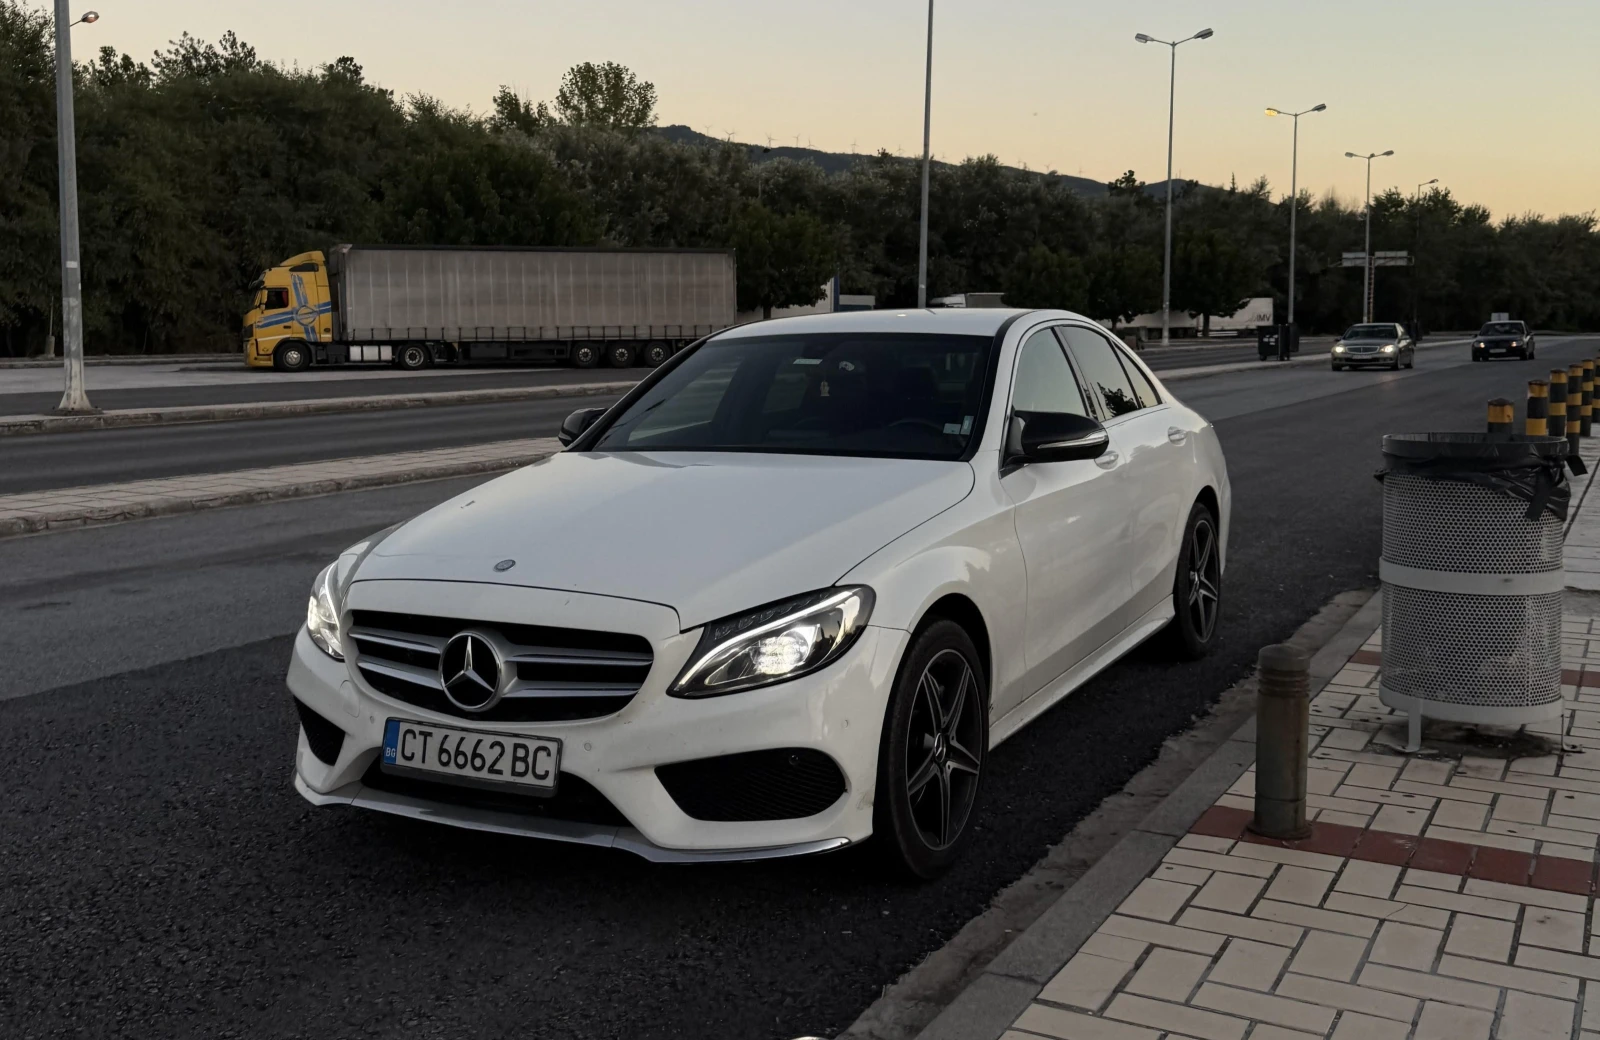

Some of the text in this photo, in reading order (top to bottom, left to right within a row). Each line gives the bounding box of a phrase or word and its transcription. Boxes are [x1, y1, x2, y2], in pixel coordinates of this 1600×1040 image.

[385, 747, 396, 757] BG
[401, 729, 552, 780] CT 6662 BC
